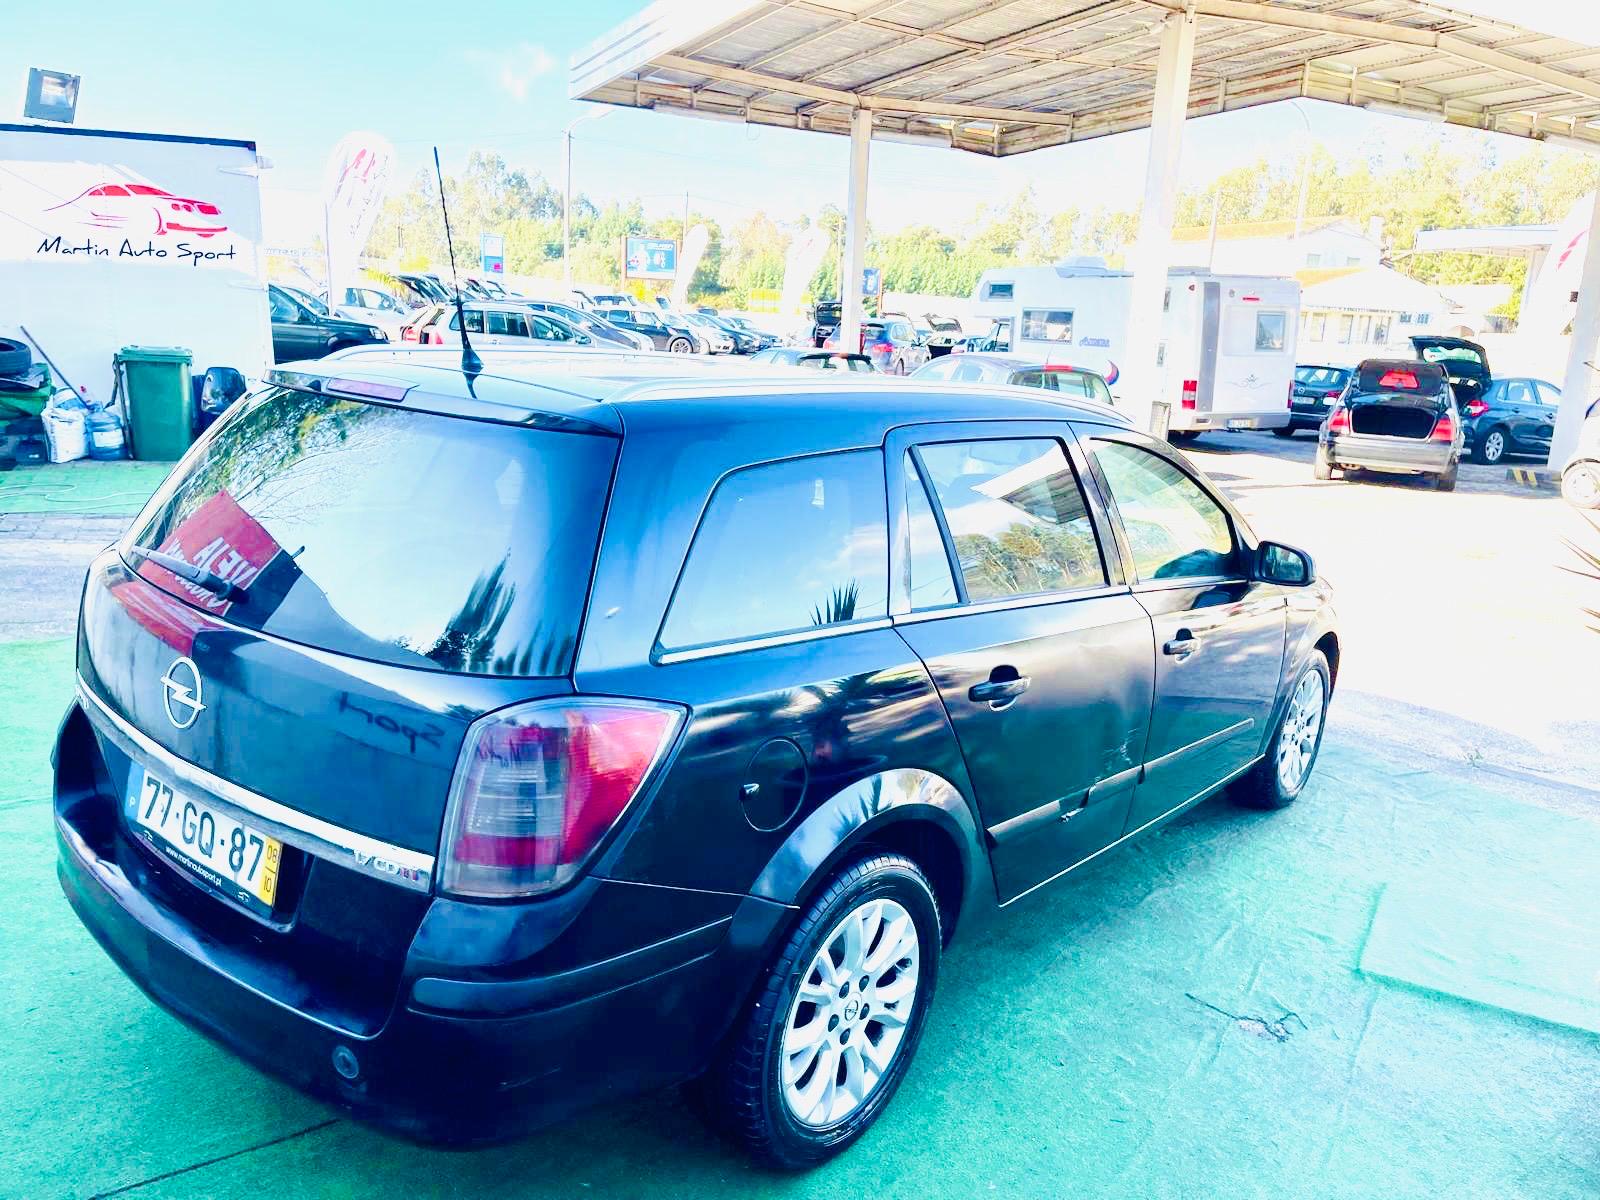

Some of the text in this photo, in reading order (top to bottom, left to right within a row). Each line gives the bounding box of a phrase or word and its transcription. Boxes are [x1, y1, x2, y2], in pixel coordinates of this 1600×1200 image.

[37, 236, 237, 266] Martin Auto Sport
[128, 796, 136, 808] P
[266, 845, 278, 864] 08
[262, 876, 273, 893] 10
